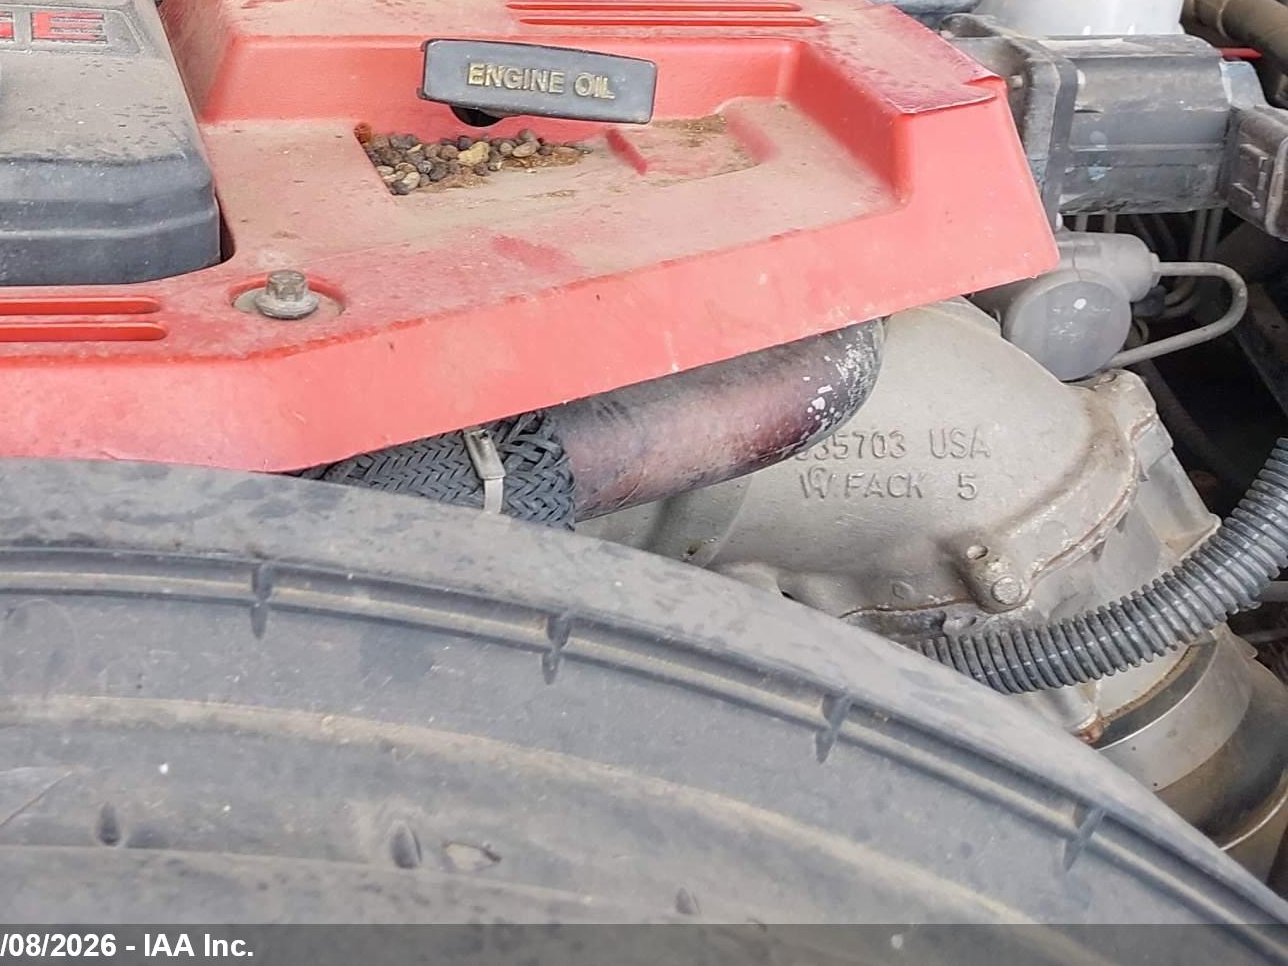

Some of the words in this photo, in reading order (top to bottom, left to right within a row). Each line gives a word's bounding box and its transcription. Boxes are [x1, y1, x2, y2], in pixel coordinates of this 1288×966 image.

[467, 62, 566, 94] ENGINE
[574, 72, 616, 100] OIL
[928, 427, 992, 459] USA
[956, 472, 978, 501] 5
